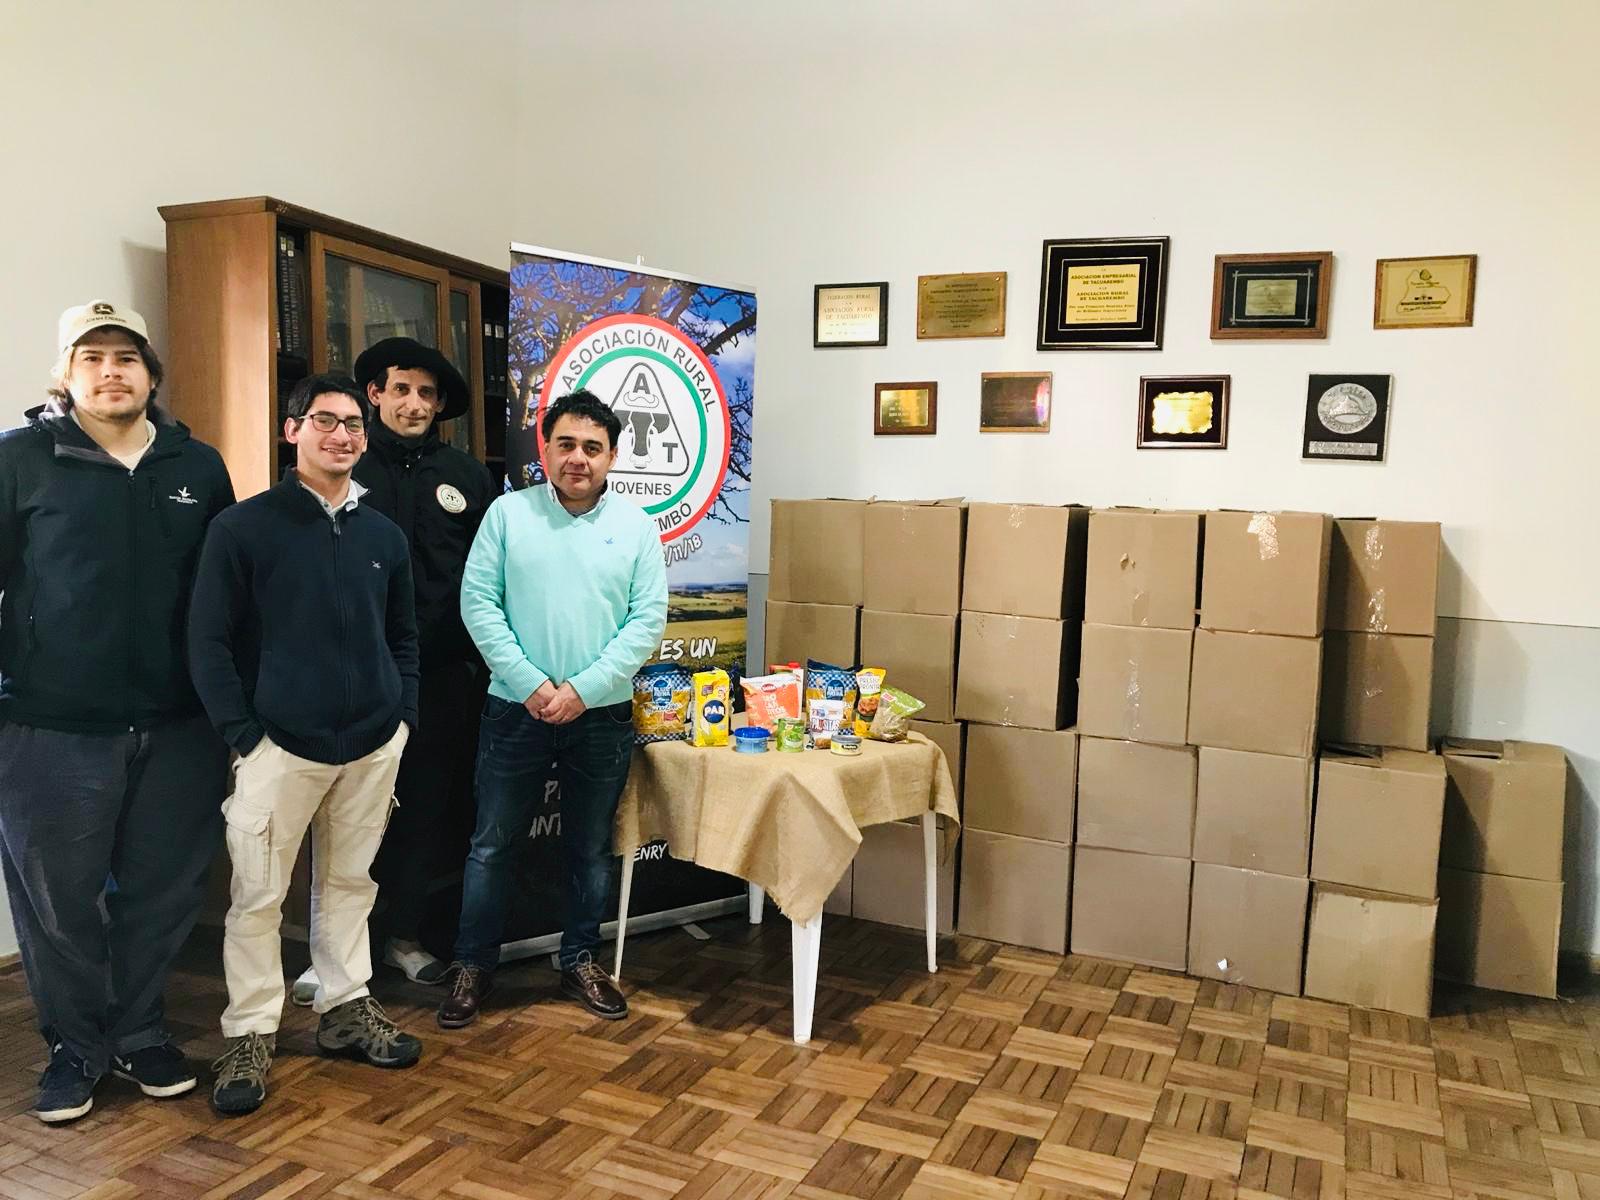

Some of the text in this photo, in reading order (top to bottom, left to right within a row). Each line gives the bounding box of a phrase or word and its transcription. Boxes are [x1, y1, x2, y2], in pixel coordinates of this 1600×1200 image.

[562, 328, 716, 413] ASOCIACIÓN RURAL
[656, 501, 692, 532] MBÓ
[665, 533, 703, 567] /11/18
[659, 637, 716, 661] ES UN
[544, 779, 561, 804] P
[632, 843, 668, 862] ENRY
